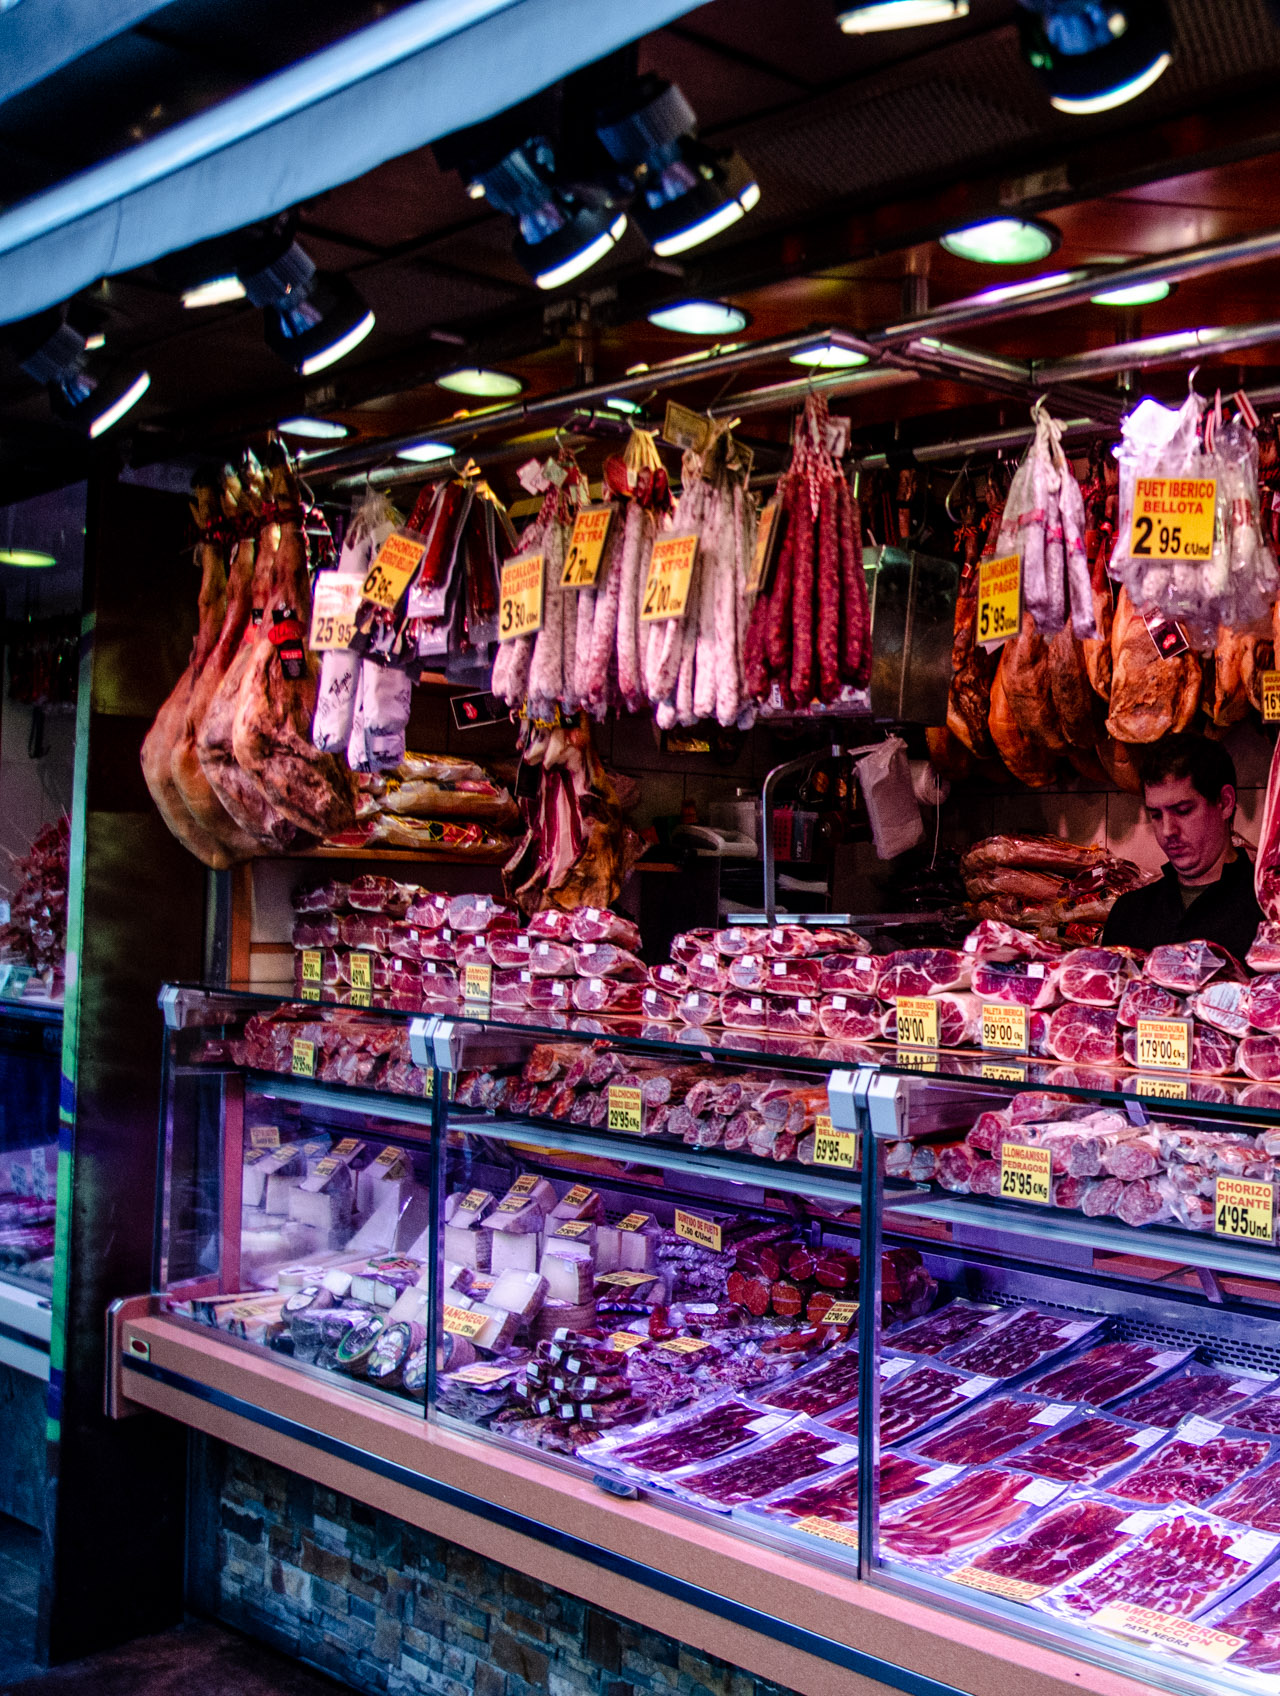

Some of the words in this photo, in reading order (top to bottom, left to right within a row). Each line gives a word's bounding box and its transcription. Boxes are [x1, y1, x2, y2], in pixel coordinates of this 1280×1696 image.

[1138, 481, 1166, 498] FUET
[1169, 482, 1214, 498] IBERICO
[1144, 501, 1203, 515] BELLOTA
[577, 511, 609, 529] FUET
[573, 529, 604, 544] EXTRA
[1133, 516, 1181, 555] 2'95
[385, 537, 424, 561] CHORIZO
[981, 583, 991, 599] DE
[993, 576, 1019, 596] PAGES
[501, 599, 526, 632] 3'50
[980, 603, 1006, 636] 5'95
[315, 616, 352, 643] 25'95
[915, 1001, 935, 1010] IBERICO
[983, 1007, 1001, 1015] PALETA
[1002, 1007, 1024, 1017] IBERICA
[983, 1015, 1010, 1024] BELLOTA
[1140, 1023, 1185, 1033] EXTREMADURA
[898, 1017, 925, 1043] 99'00
[984, 1023, 1013, 1041] 99'00
[1140, 1039, 1172, 1060] 179'00
[609, 1109, 630, 1128] 29'95
[818, 1128, 850, 1139] BELLOTA
[816, 1138, 840, 1162] 69'95
[1003, 1146, 1049, 1164] LLONGANISSA
[1002, 1160, 1048, 1174] PEDRAGOSA
[1002, 1170, 1032, 1195] 25'95
[1217, 1181, 1271, 1198] CHORIZO
[1217, 1193, 1271, 1210] PICANTE
[677, 1212, 697, 1228] SURTIDO
[697, 1220, 704, 1231] DE
[961, 1567, 1022, 1587] GUIJUELO
[1109, 1602, 1169, 1624] JAMON
[1169, 1616, 1241, 1648] IBERICO
[1125, 1614, 1213, 1647] SELECCION
[1122, 1623, 1150, 1635] PATA
[1151, 1631, 1190, 1648] NEGRA
